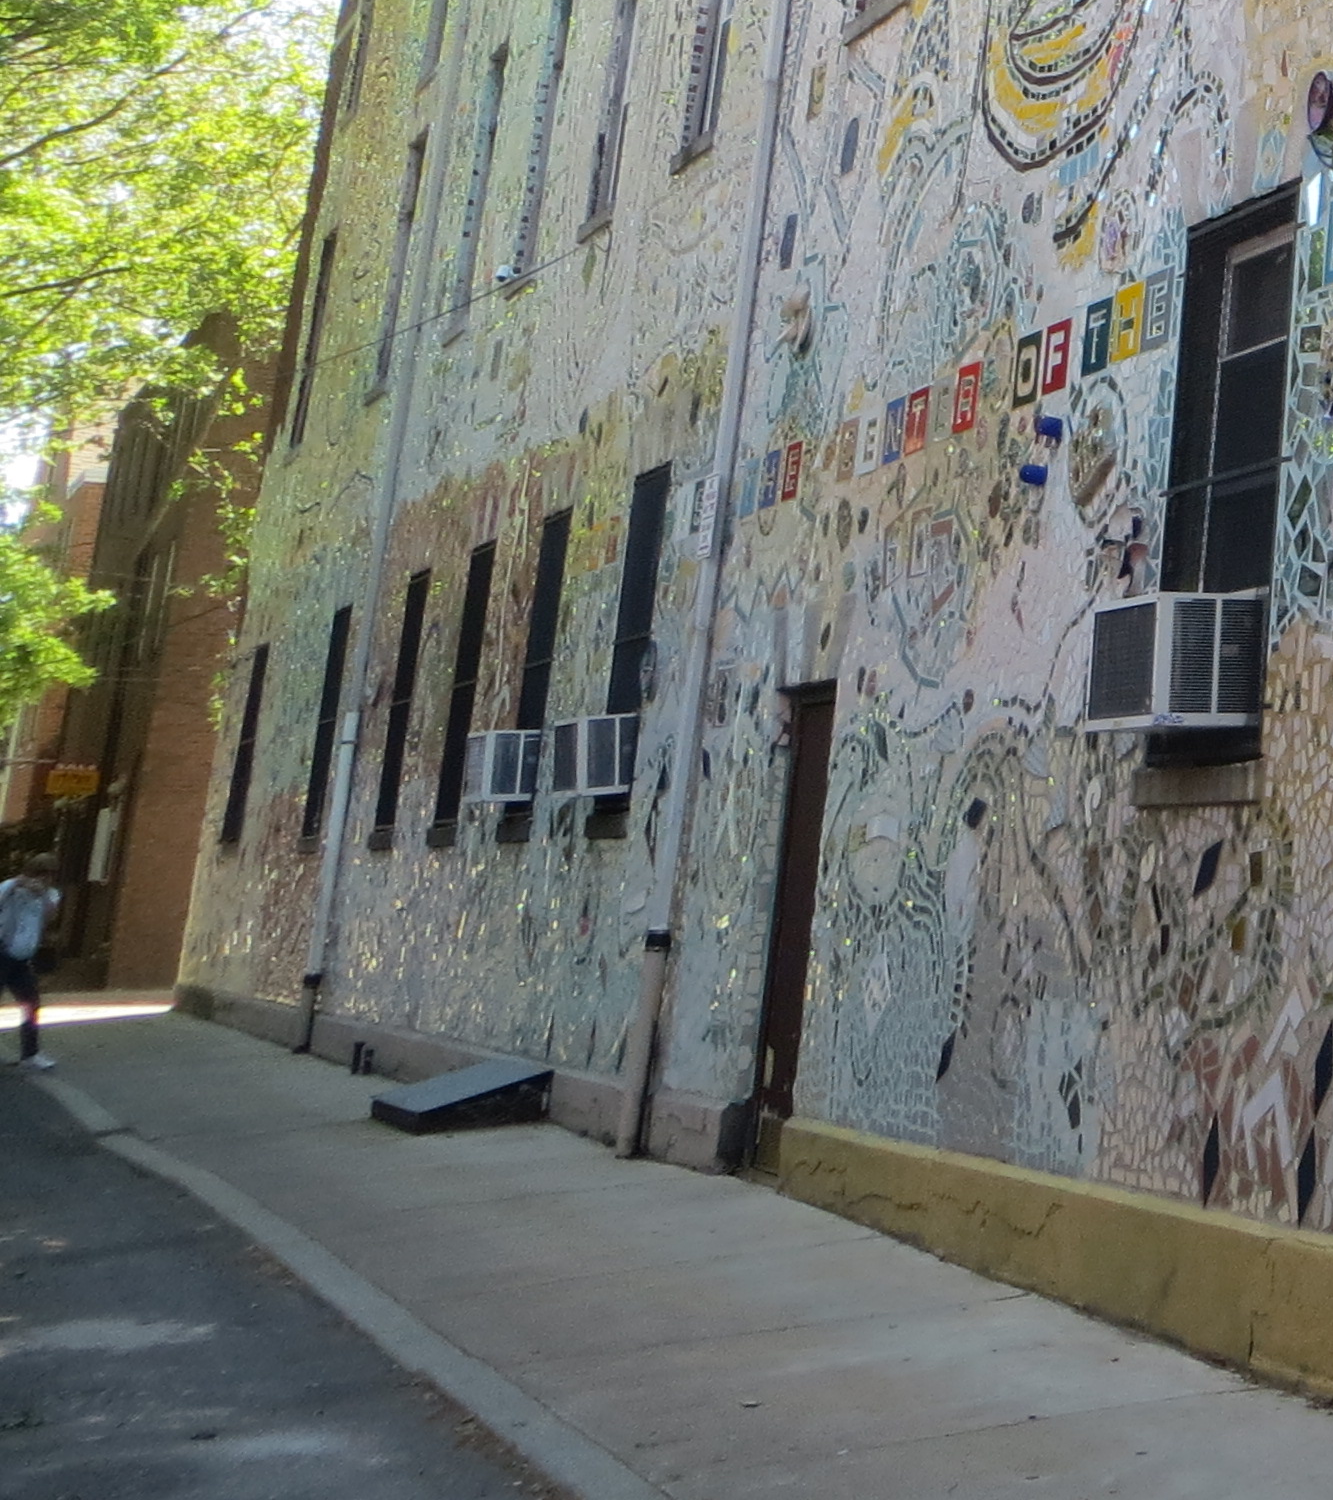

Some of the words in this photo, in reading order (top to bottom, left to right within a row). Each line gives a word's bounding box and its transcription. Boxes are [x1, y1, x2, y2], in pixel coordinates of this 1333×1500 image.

[839, 365, 982, 476] CENTER
[1015, 321, 1072, 406] OF
[1084, 274, 1172, 373] THE
